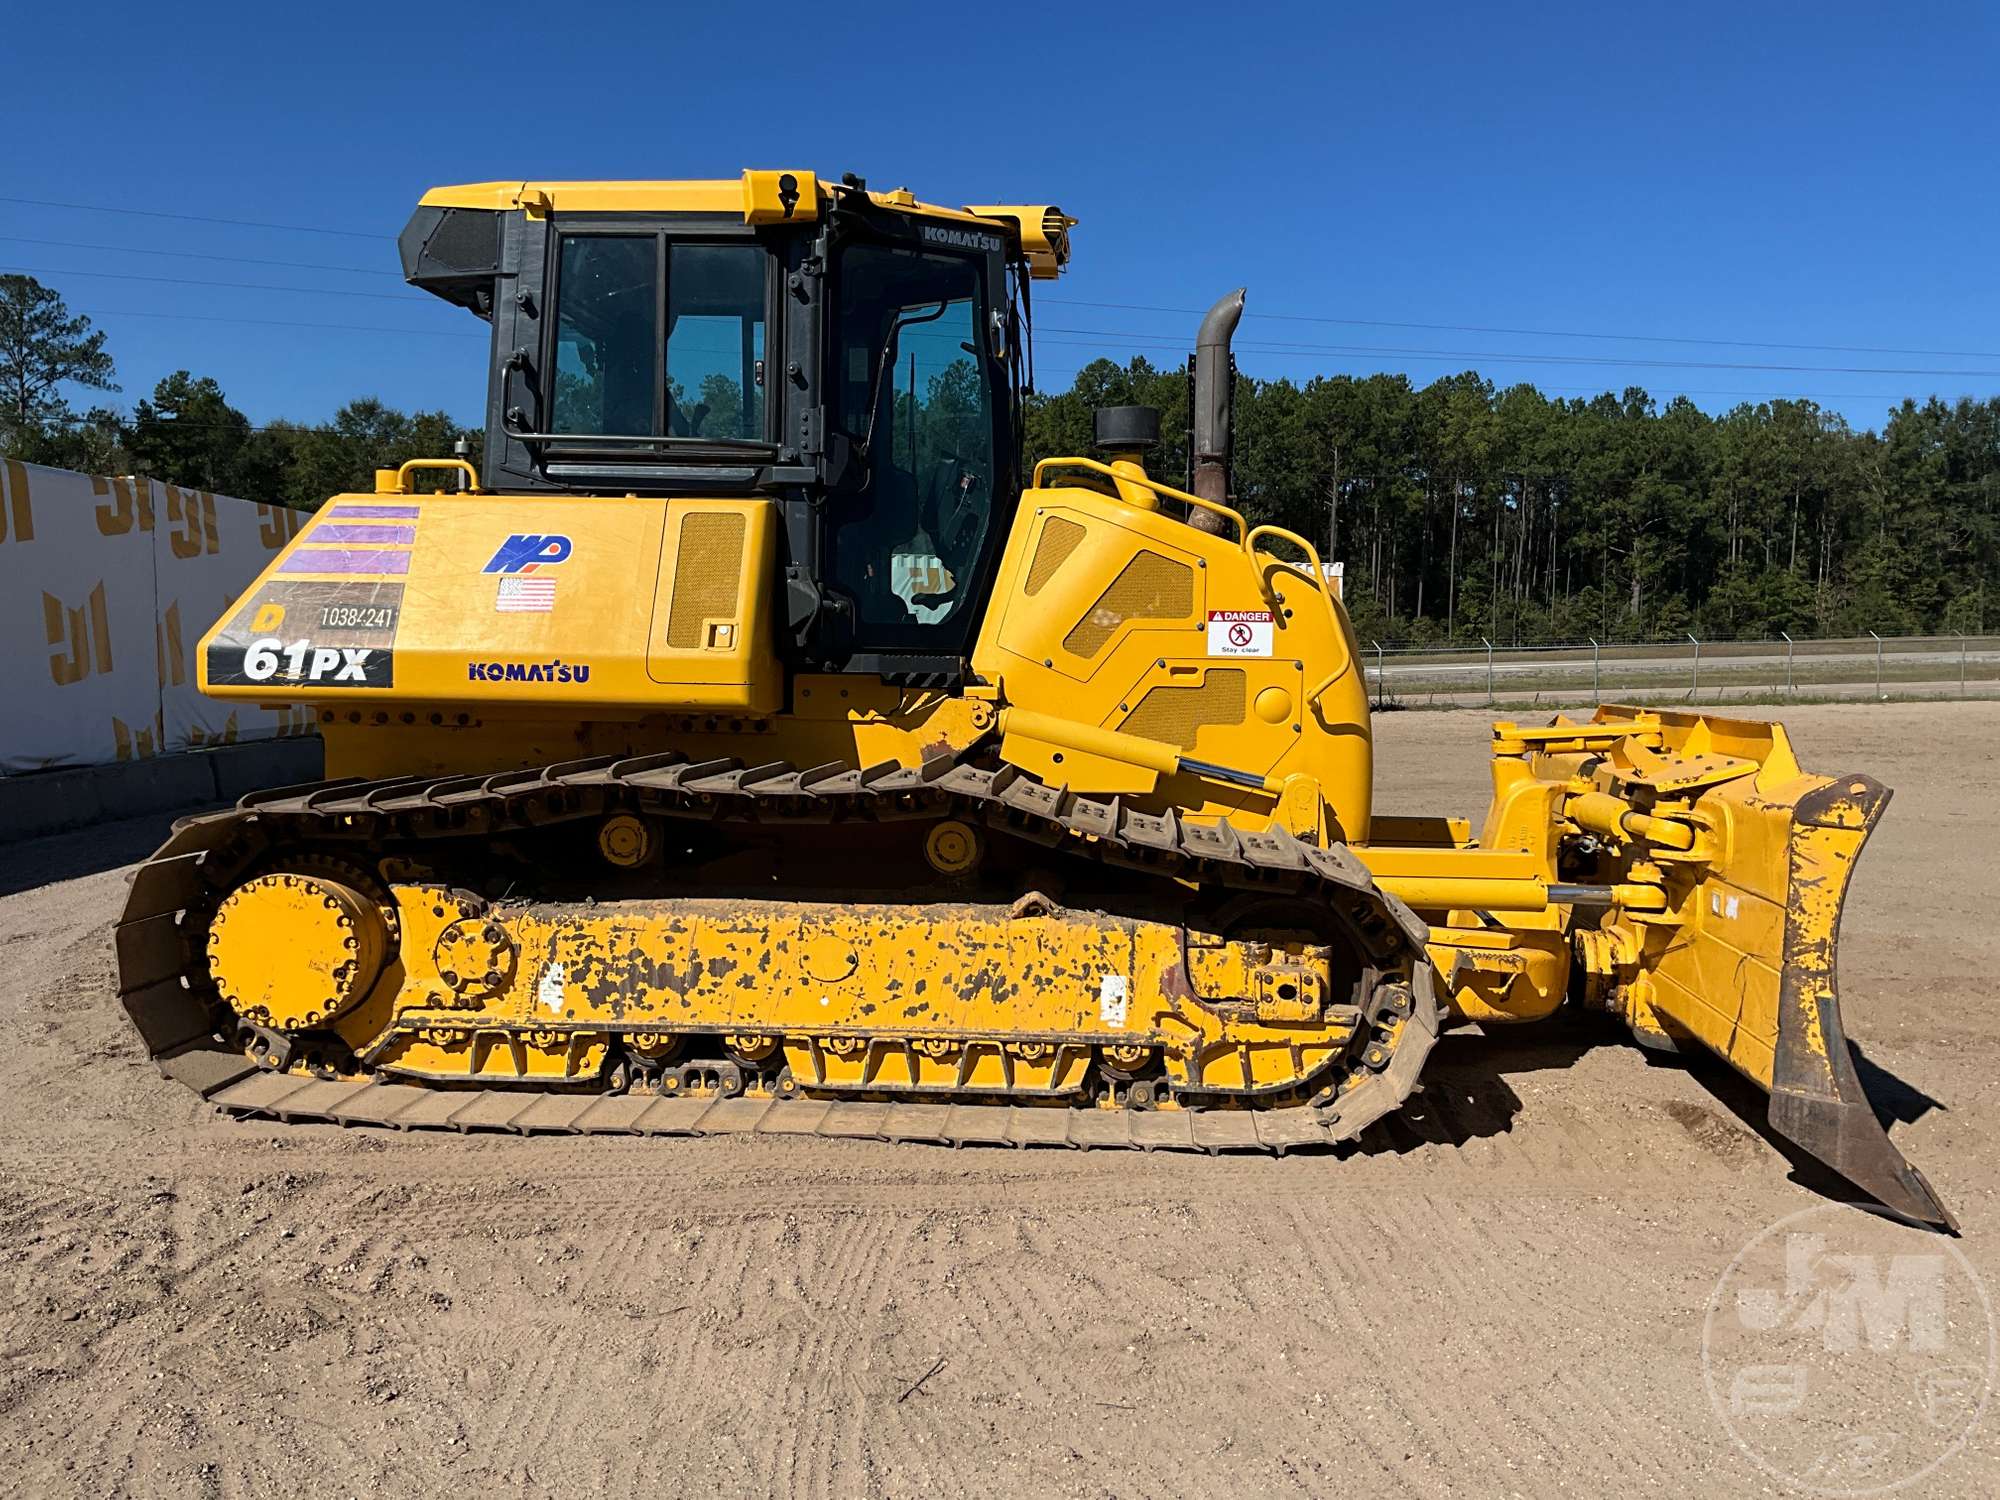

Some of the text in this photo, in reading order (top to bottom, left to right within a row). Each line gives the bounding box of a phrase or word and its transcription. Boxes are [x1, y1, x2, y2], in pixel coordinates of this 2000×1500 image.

[924, 226, 1000, 251] KOMATSU
[251, 603, 286, 633] D
[1224, 612, 1270, 621] DANGER
[468, 659, 590, 683] KOMATSU
